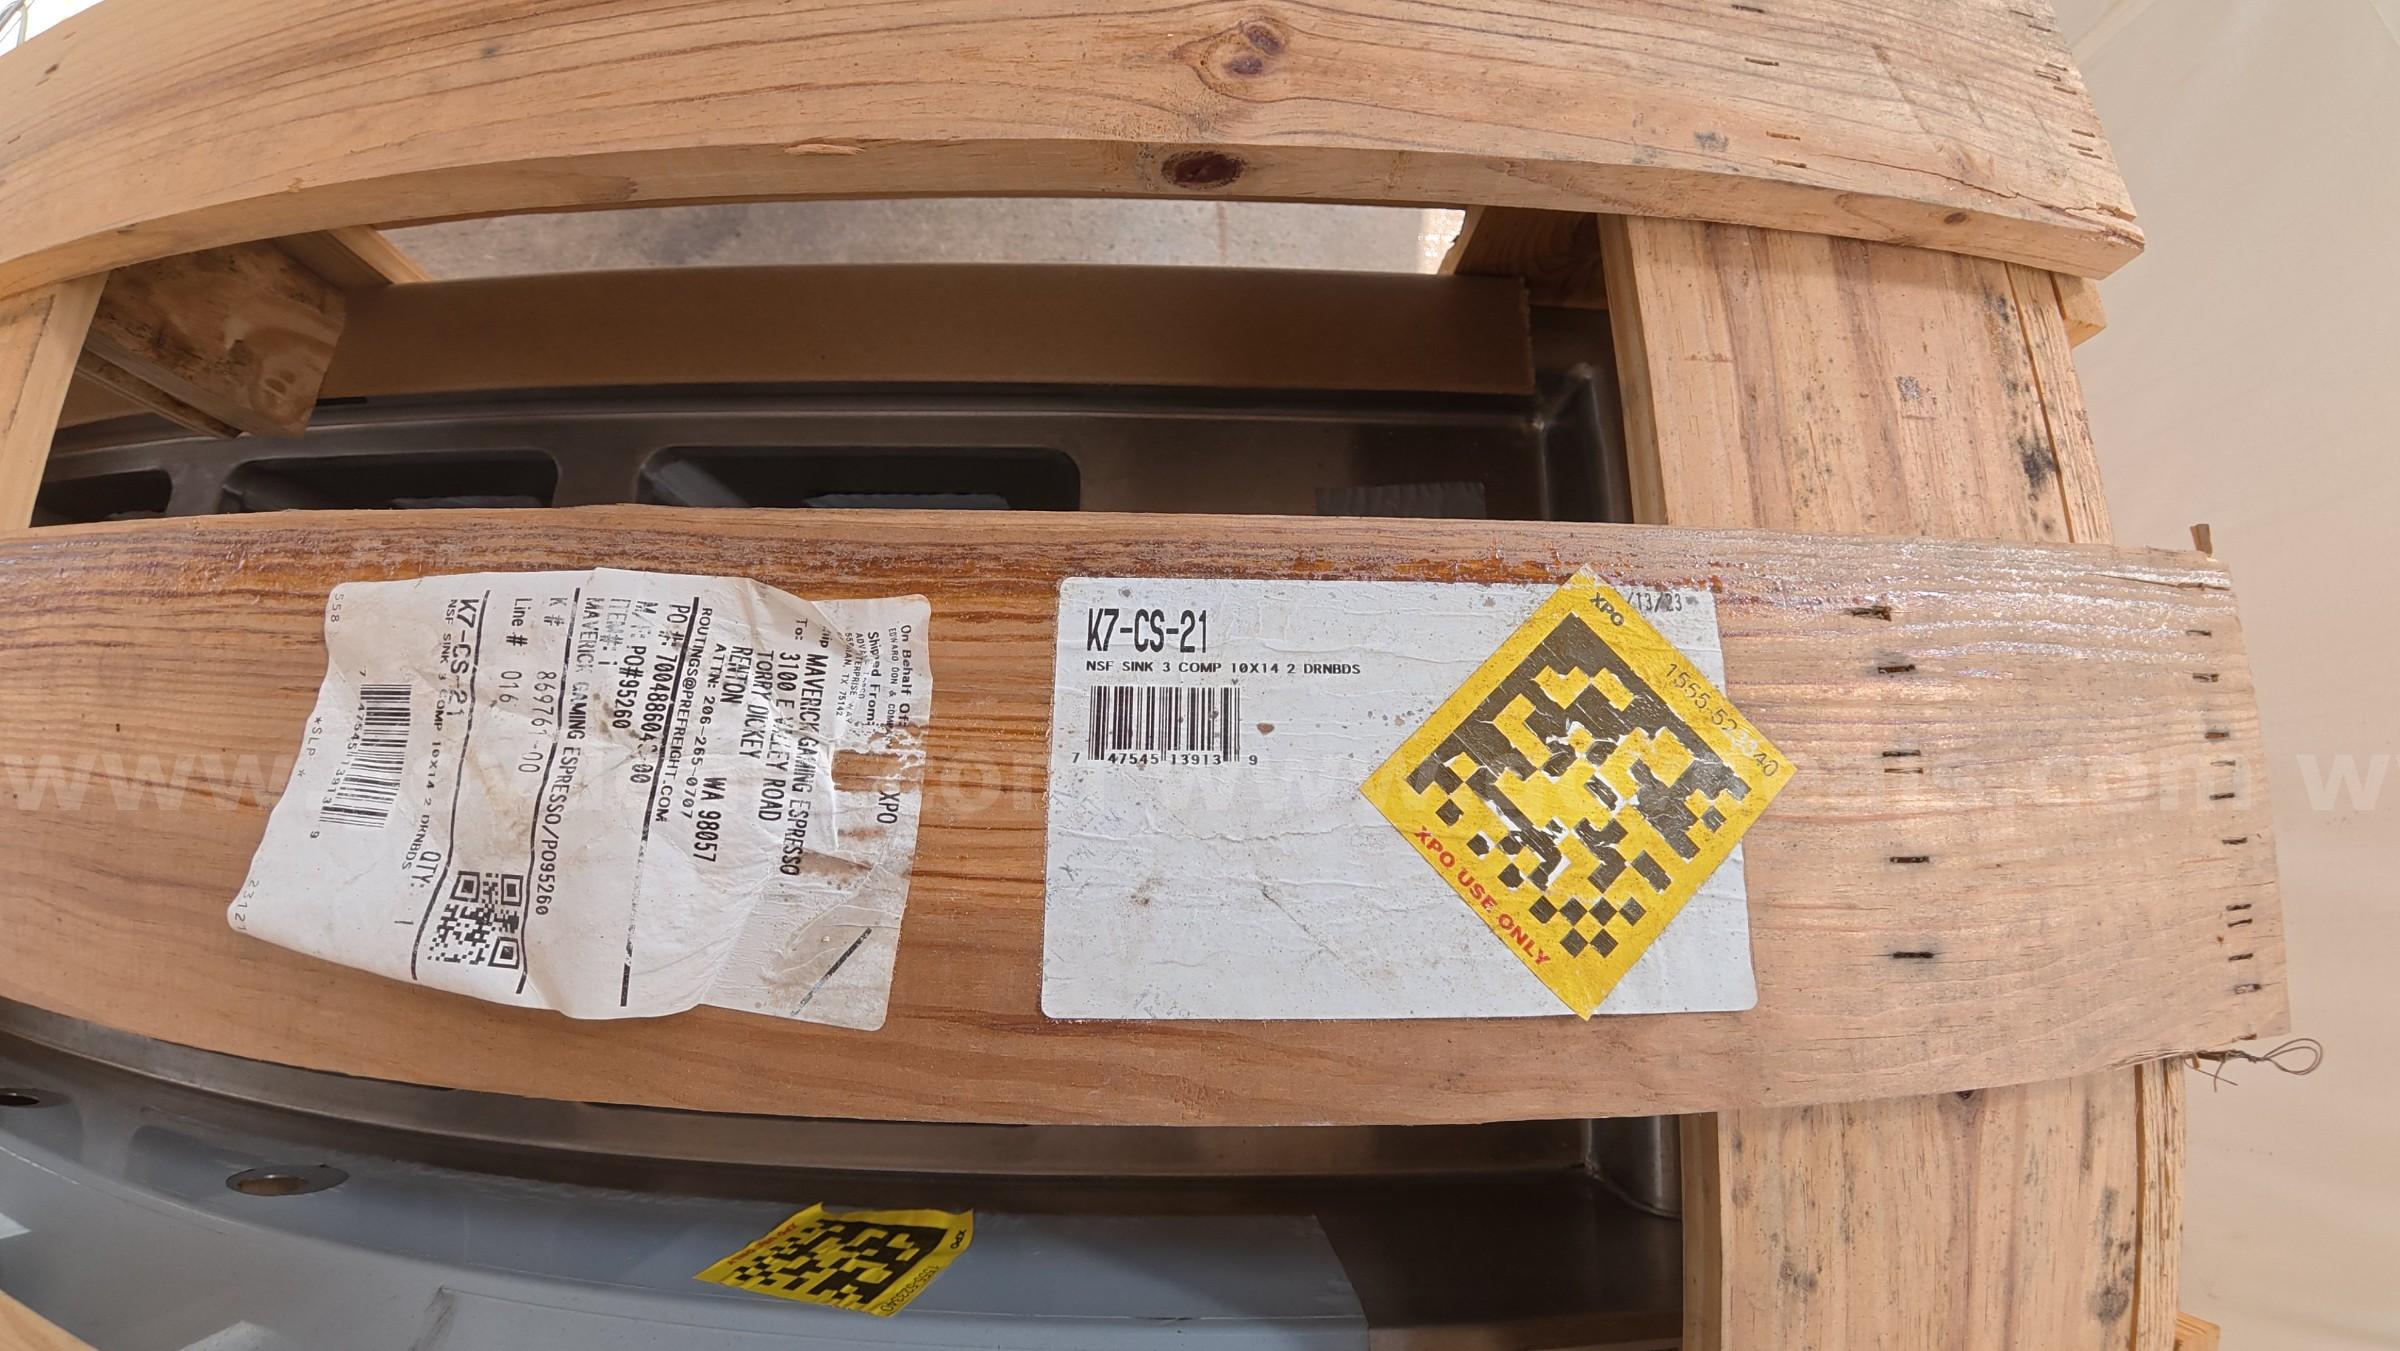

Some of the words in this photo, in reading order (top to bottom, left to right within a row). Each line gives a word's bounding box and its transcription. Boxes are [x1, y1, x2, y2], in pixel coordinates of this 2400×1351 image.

[444, 599, 457, 625] NSF
[511, 598, 533, 627] Line
[667, 604, 691, 624] PO
[794, 618, 808, 640] To:
[1086, 607, 1207, 653] K7-CS-21
[1590, 592, 1625, 627] XPO
[440, 633, 451, 664] SINK
[506, 632, 528, 647] #
[576, 597, 605, 674] MAVERICK
[901, 624, 912, 642] On
[447, 599, 479, 716] K7-CS-21
[707, 643, 727, 688] ATTN:
[720, 646, 753, 705] RENTON
[751, 650, 774, 701] TORRY
[777, 652, 801, 691] 3100
[901, 650, 912, 695] Behalf
[1086, 660, 1114, 672] NSF
[1122, 661, 1154, 672] SINK
[1162, 661, 1171, 672] 3
[1178, 661, 1222, 673] COMP
[1231, 662, 1279, 674] 10X14
[1287, 663, 1296, 674] 2
[1303, 663, 1361, 675] DRNBDS
[498, 670, 522, 703] 016
[612, 645, 647, 729] PO#95260
[799, 653, 829, 734] MAVERICK
[841, 673, 849, 685] TX
[566, 681, 589, 740] GAMING
[655, 607, 713, 822] ROUTINGS@PREFREIGHT.COM
[776, 699, 795, 709] E
[835, 691, 844, 717] 75142
[739, 704, 770, 760] DICKEY
[681, 695, 715, 819] 206-265-0707
[791, 737, 819, 794] GAMING
[1072, 752, 1080, 764] 7
[1107, 753, 1160, 765] 47545
[1170, 753, 1222, 765] 13913
[1248, 754, 1258, 765] 9
[701, 777, 728, 801] WA
[758, 778, 786, 821] ROAD
[876, 791, 899, 825] XPO
[535, 746, 581, 916] ESPRESSO/PO95260
[693, 810, 722, 863] 98057
[779, 799, 811, 876] ESPRESSO
[410, 850, 442, 888] QTY:
[1414, 825, 1455, 868] XPO
[1457, 868, 1498, 914] USE
[1498, 913, 1551, 965] ONLY
[950, 1229, 967, 1249] XPO
